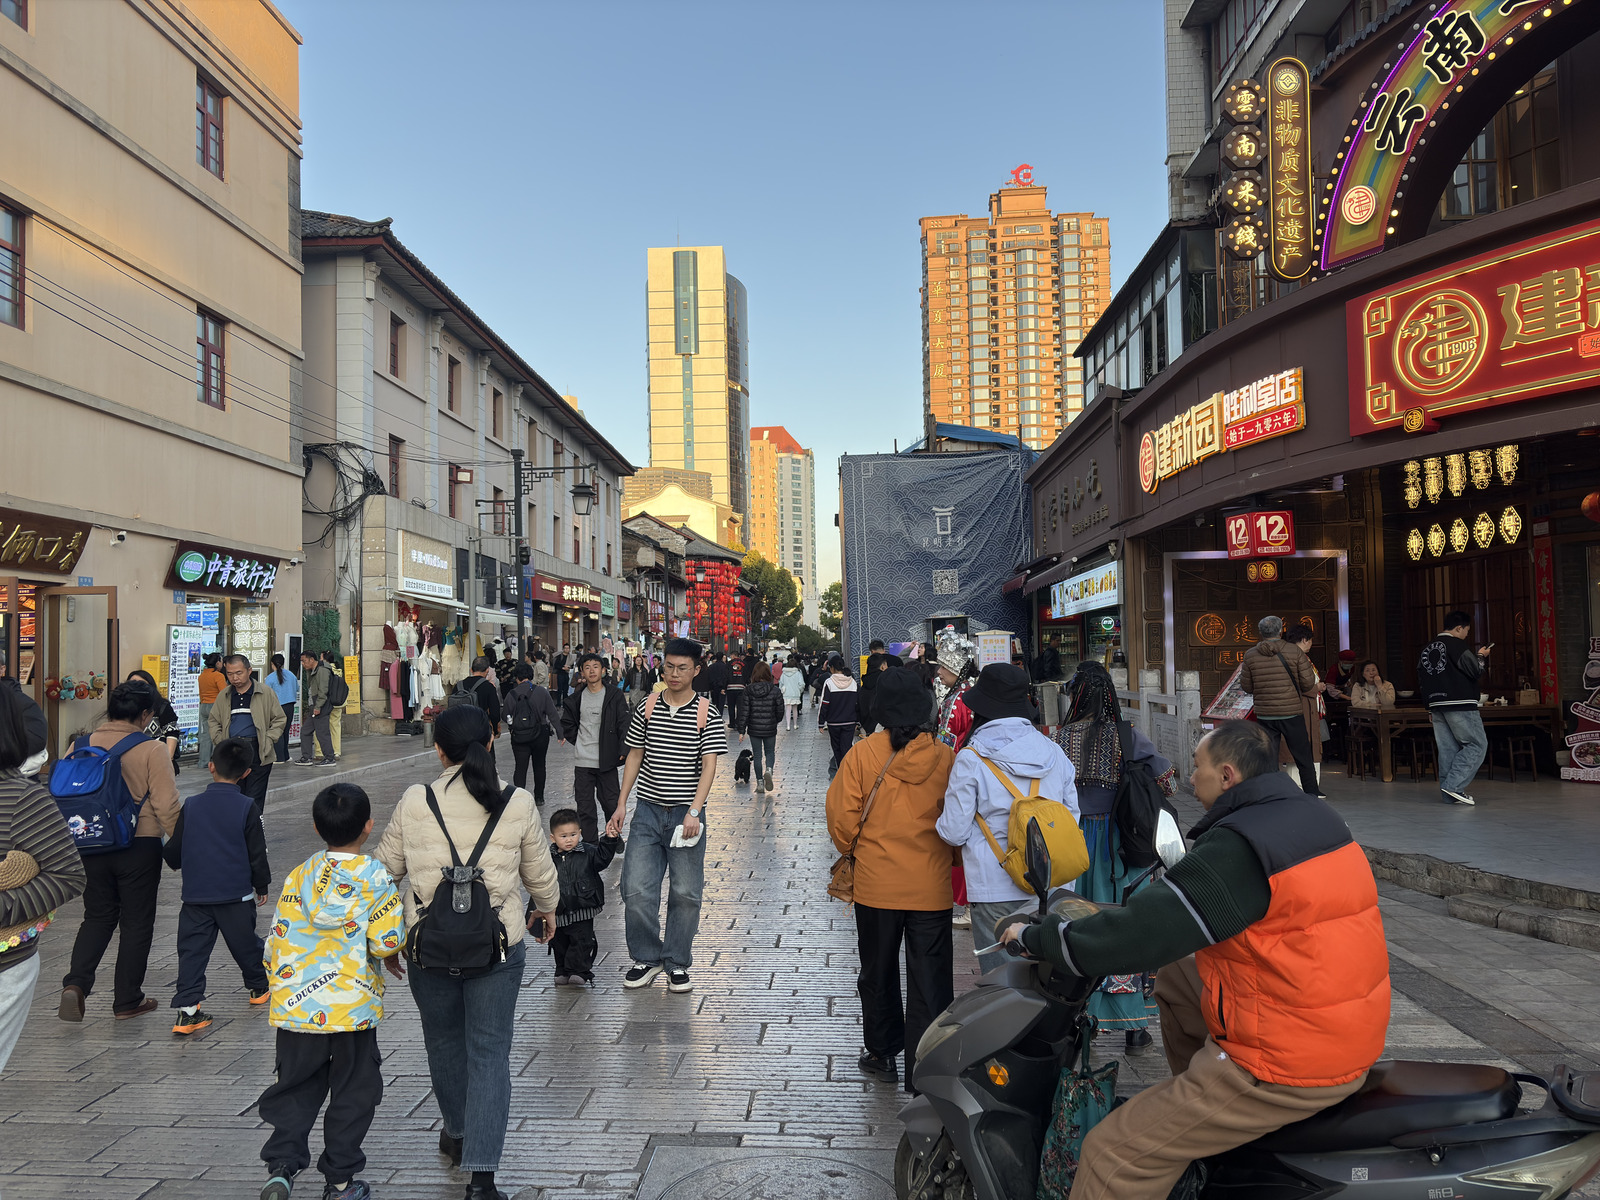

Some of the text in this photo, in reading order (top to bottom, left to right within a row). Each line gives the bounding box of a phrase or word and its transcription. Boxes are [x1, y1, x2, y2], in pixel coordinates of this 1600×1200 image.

[1275, 98, 1305, 270] 非物质文化遗产
[1497, 262, 1600, 350] 建
[1449, 338, 1478, 355] 1906
[1223, 369, 1297, 425] 胜利堂店
[1154, 392, 1221, 480] 建新园
[1228, 412, 1293, 444] 始于一九零六年
[0, 521, 63, 564] 俩口
[1229, 518, 1248, 546] 12
[1256, 514, 1288, 542] 12
[1408, 515, 1519, 556] 中华老字号
[207, 553, 277, 593] 中青旅行社
[287, 969, 339, 1008] G.DUCKKIDS
[1427, 1187, 1454, 1199] 新日
